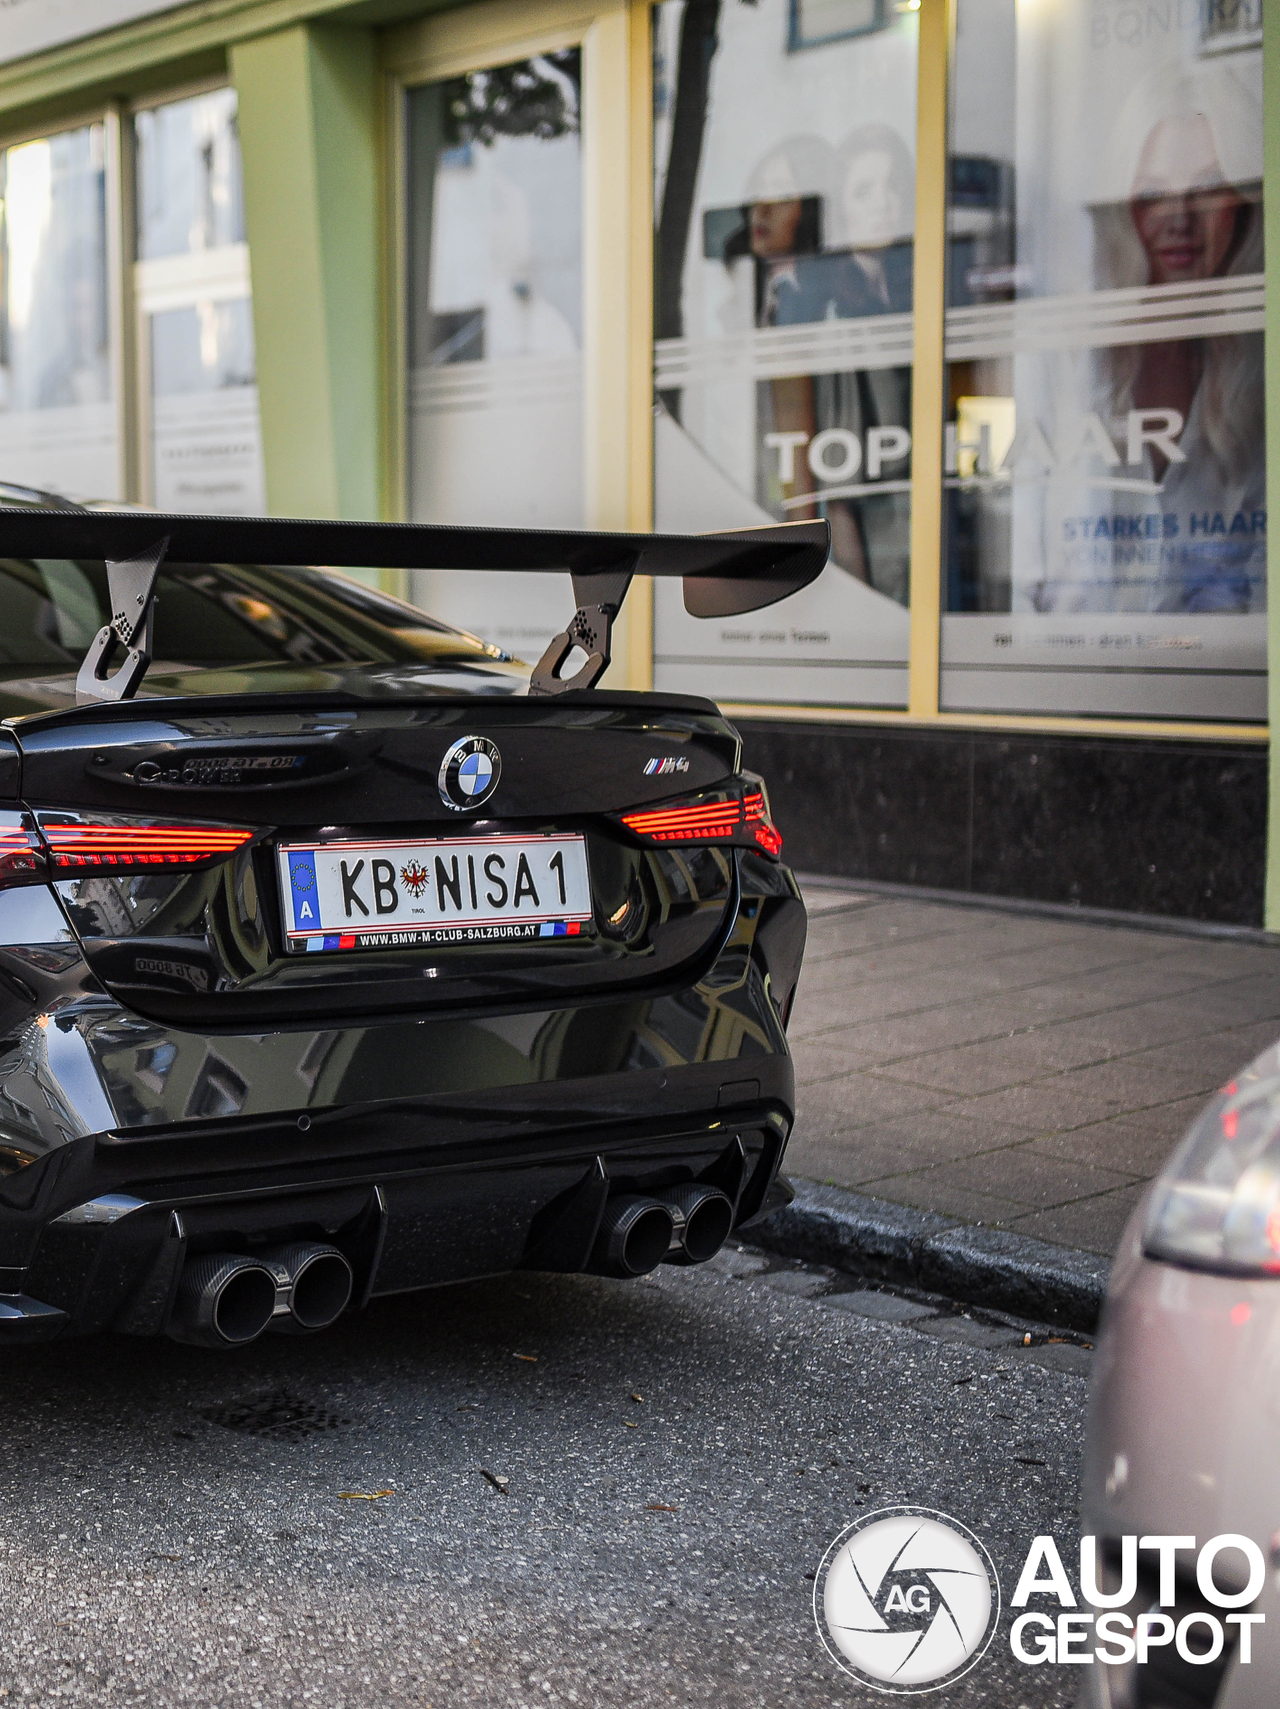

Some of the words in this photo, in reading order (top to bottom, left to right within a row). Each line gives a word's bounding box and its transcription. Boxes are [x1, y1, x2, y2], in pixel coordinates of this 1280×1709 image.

[764, 425, 912, 484] TOP
[945, 407, 1187, 473] HAAR
[1063, 513, 1179, 541] STARKES
[1189, 511, 1267, 538] HAAR
[454, 740, 499, 763] BMW
[339, 858, 399, 917] KB
[434, 851, 540, 911] NISA
[549, 850, 567, 905] 1
[300, 900, 313, 919] A
[360, 925, 536, 946] WWW.BMW-M-CLUB-SALZBURG.AT
